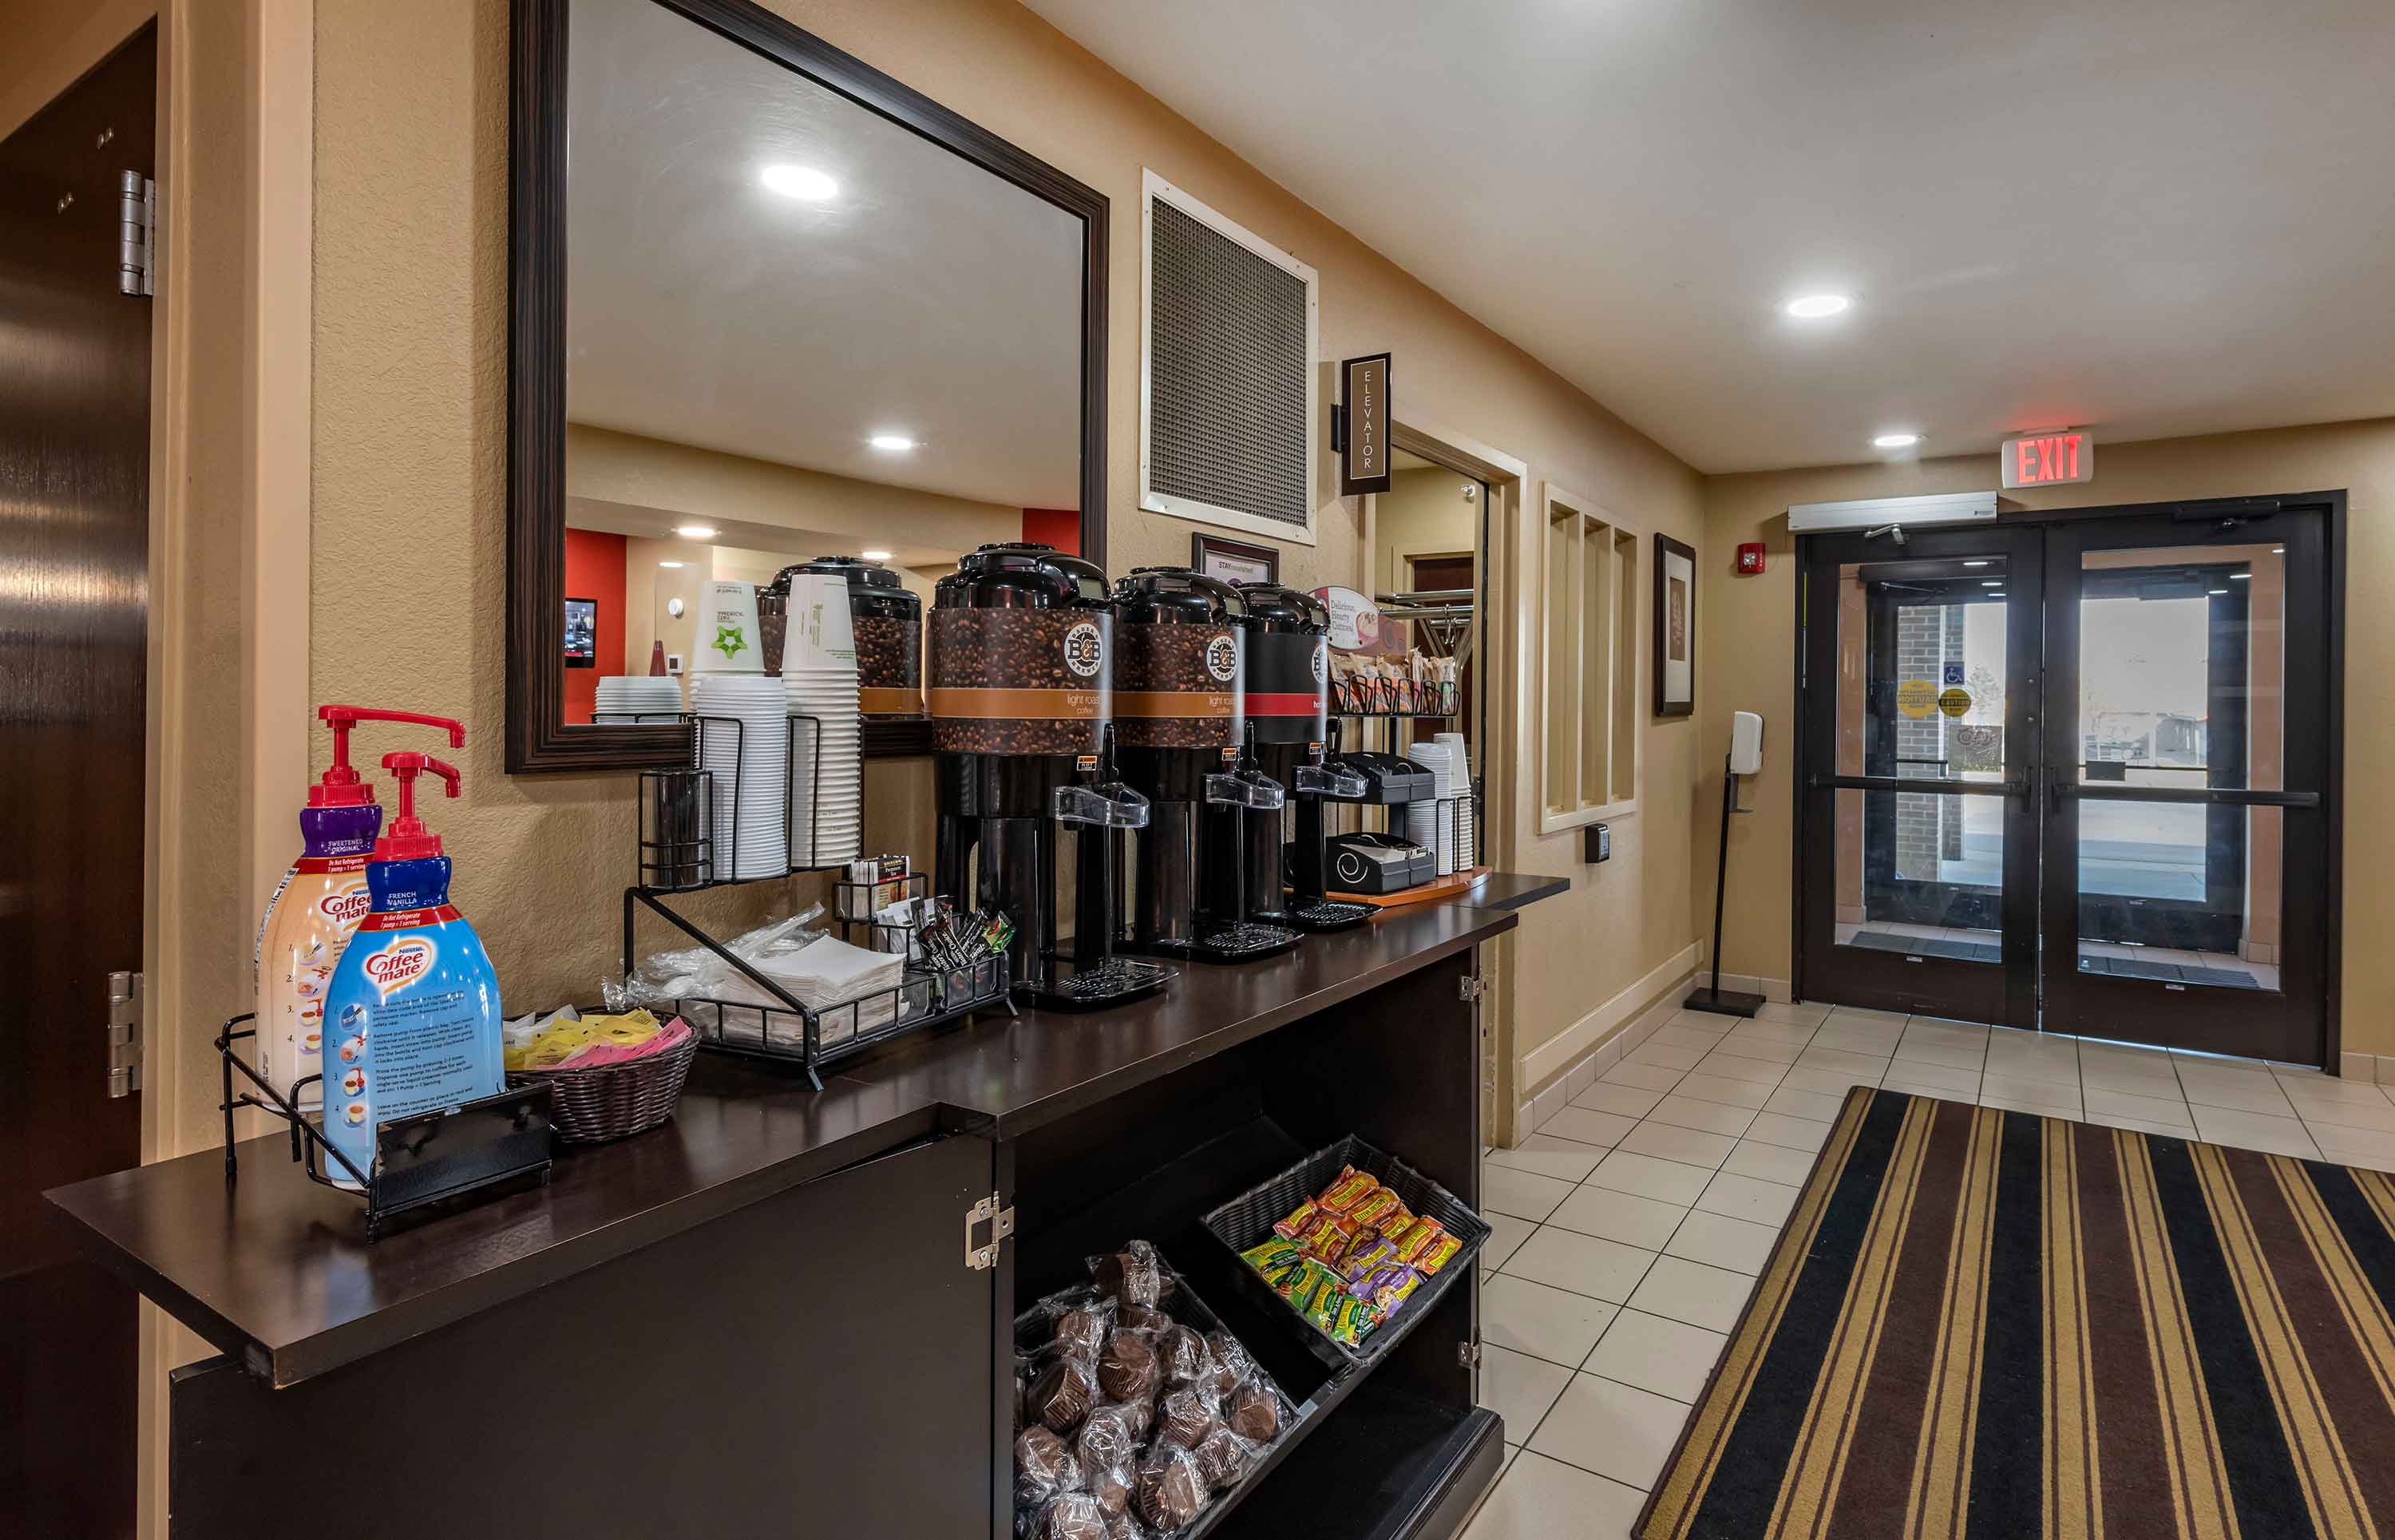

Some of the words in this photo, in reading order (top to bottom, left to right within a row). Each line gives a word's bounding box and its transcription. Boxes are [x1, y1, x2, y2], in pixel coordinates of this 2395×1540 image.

[1362, 370, 1373, 469] ELEVATOR
[2017, 433, 2083, 484] EXIT
[1067, 639, 1101, 661] B&B
[1209, 649, 1237, 668] B&B
[1067, 694, 1083, 707] light
[1209, 695, 1223, 707] light
[327, 838, 363, 847] SWEETENED
[386, 897, 418, 907] VANILLA
[388, 891, 417, 900] FRENCH
[396, 912, 421, 921] Refrigerate
[942, 931, 956, 950] Choice
[366, 952, 424, 976] Coffee
[378, 964, 421, 984] mate
